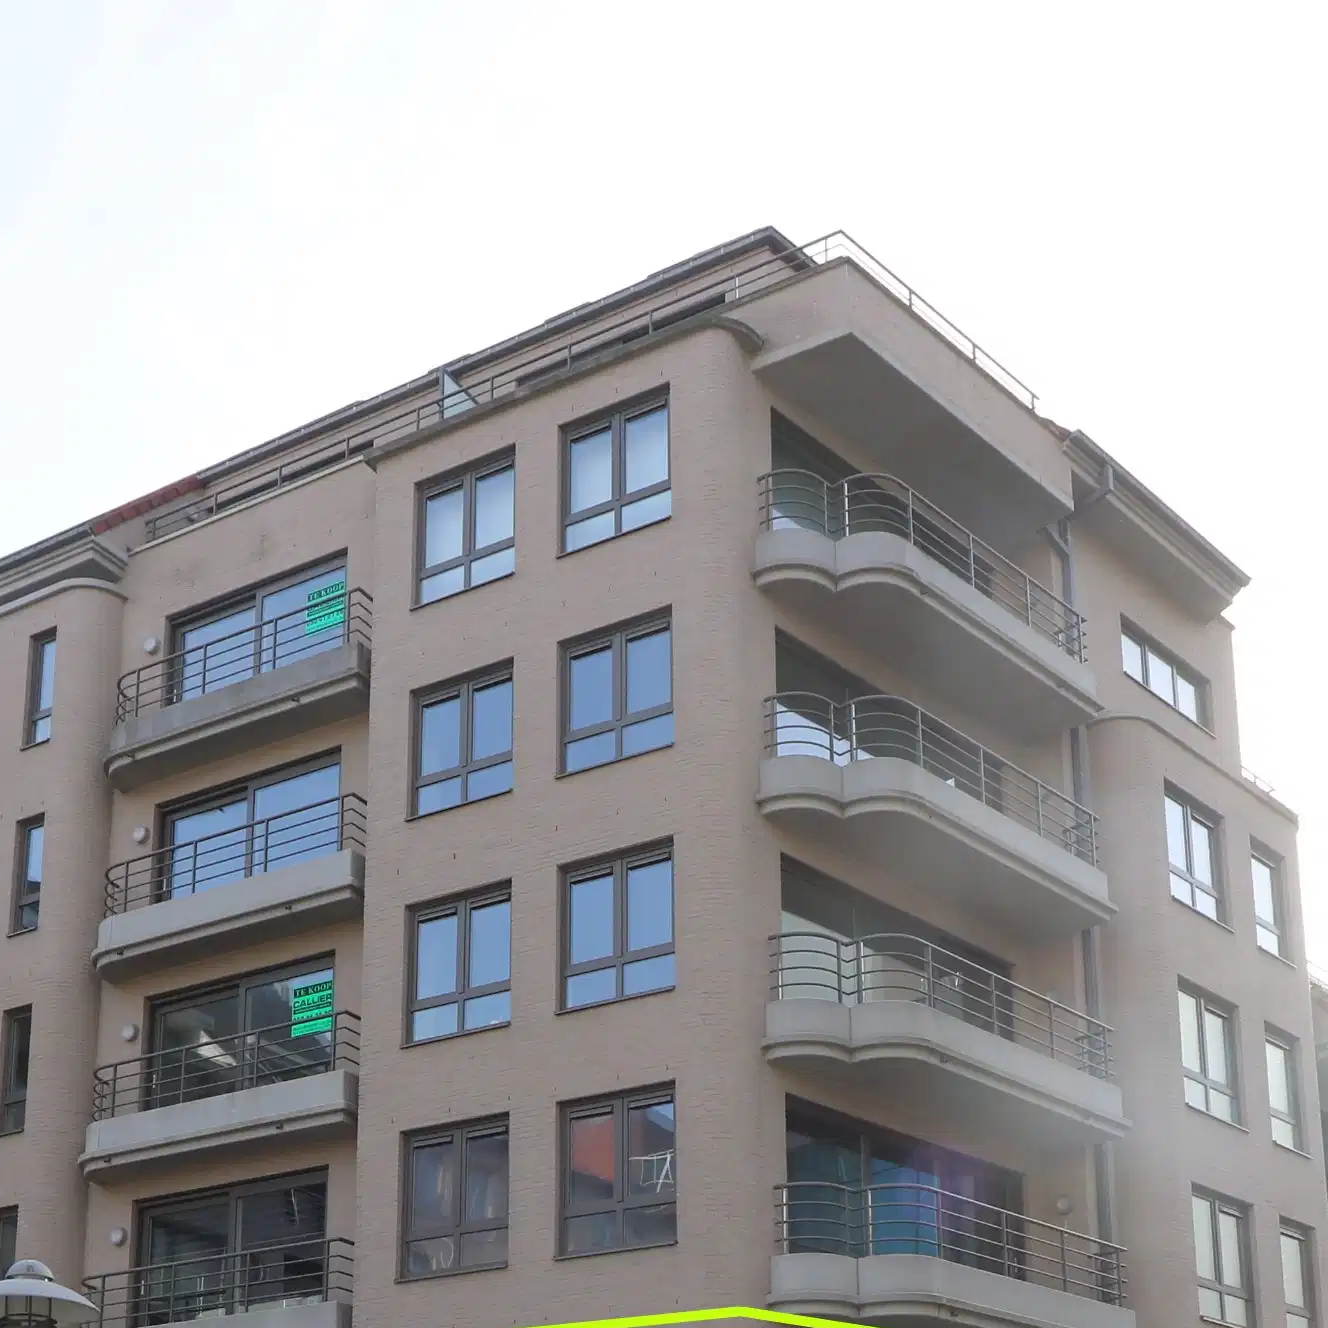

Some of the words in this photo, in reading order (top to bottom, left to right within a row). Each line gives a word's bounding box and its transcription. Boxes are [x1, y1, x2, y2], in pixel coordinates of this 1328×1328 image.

[321, 583, 344, 596] KOOP
[296, 988, 306, 997] TE
[308, 982, 332, 993] KOOP
[293, 993, 332, 1008] CALLIER
